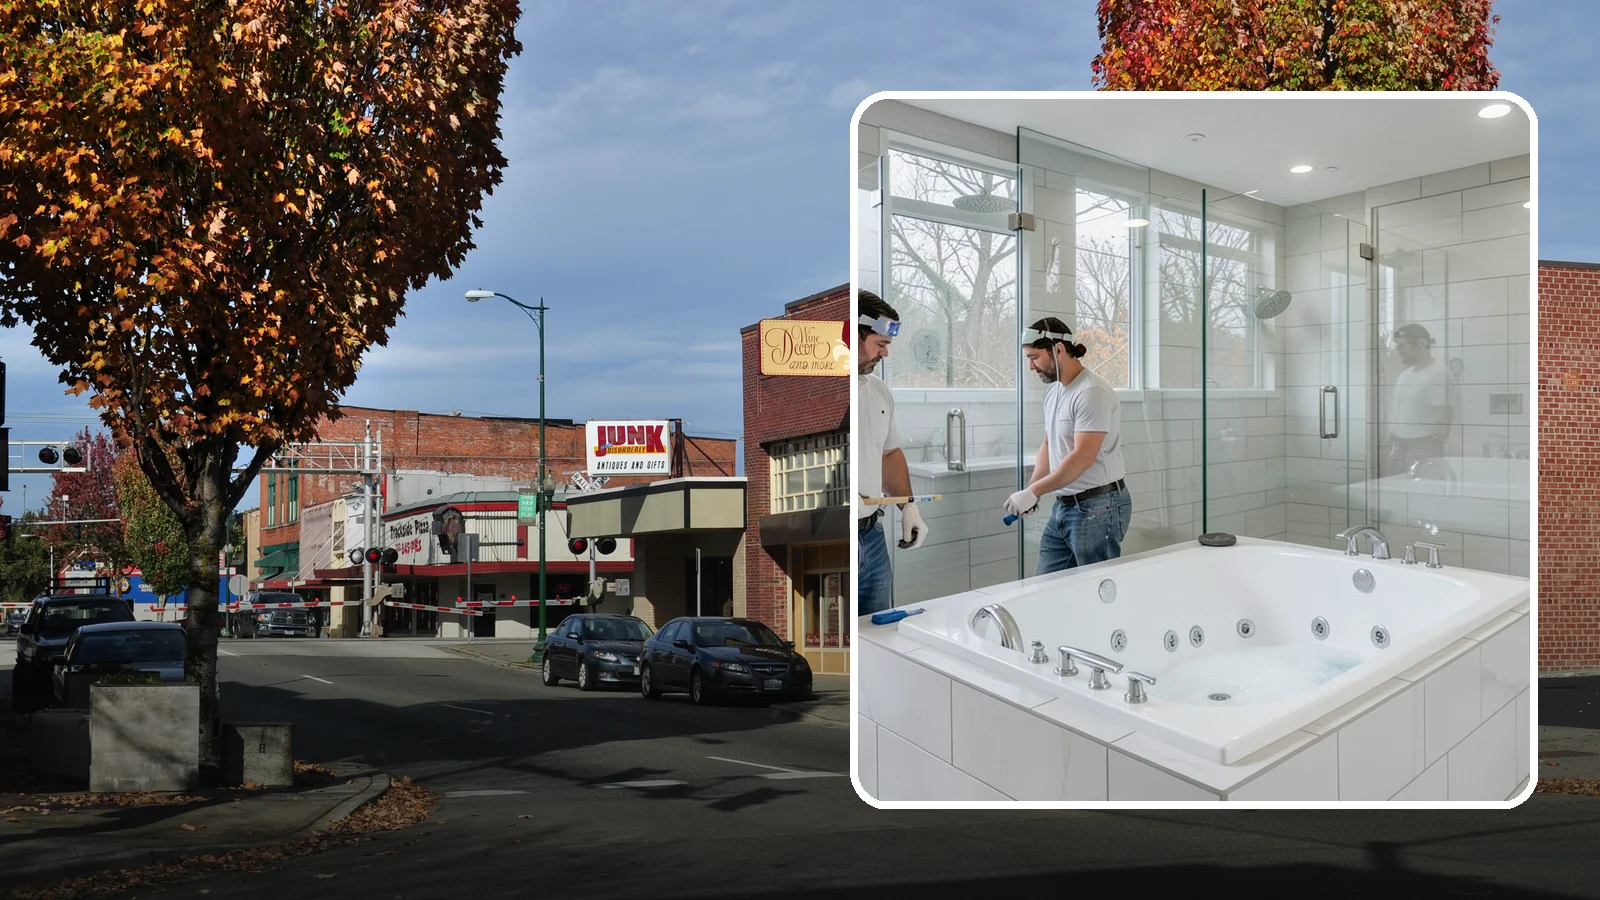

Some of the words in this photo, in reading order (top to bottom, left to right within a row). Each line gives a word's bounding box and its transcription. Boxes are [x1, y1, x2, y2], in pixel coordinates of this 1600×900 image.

[595, 425, 665, 457] JUNK
[607, 446, 646, 454] DISORDERLY
[597, 461, 628, 470] ANTIQUES
[631, 461, 644, 470] AND
[646, 460, 665, 470] GIFTS
[390, 521, 413, 540] Trackside
[414, 519, 429, 535] Pizza
